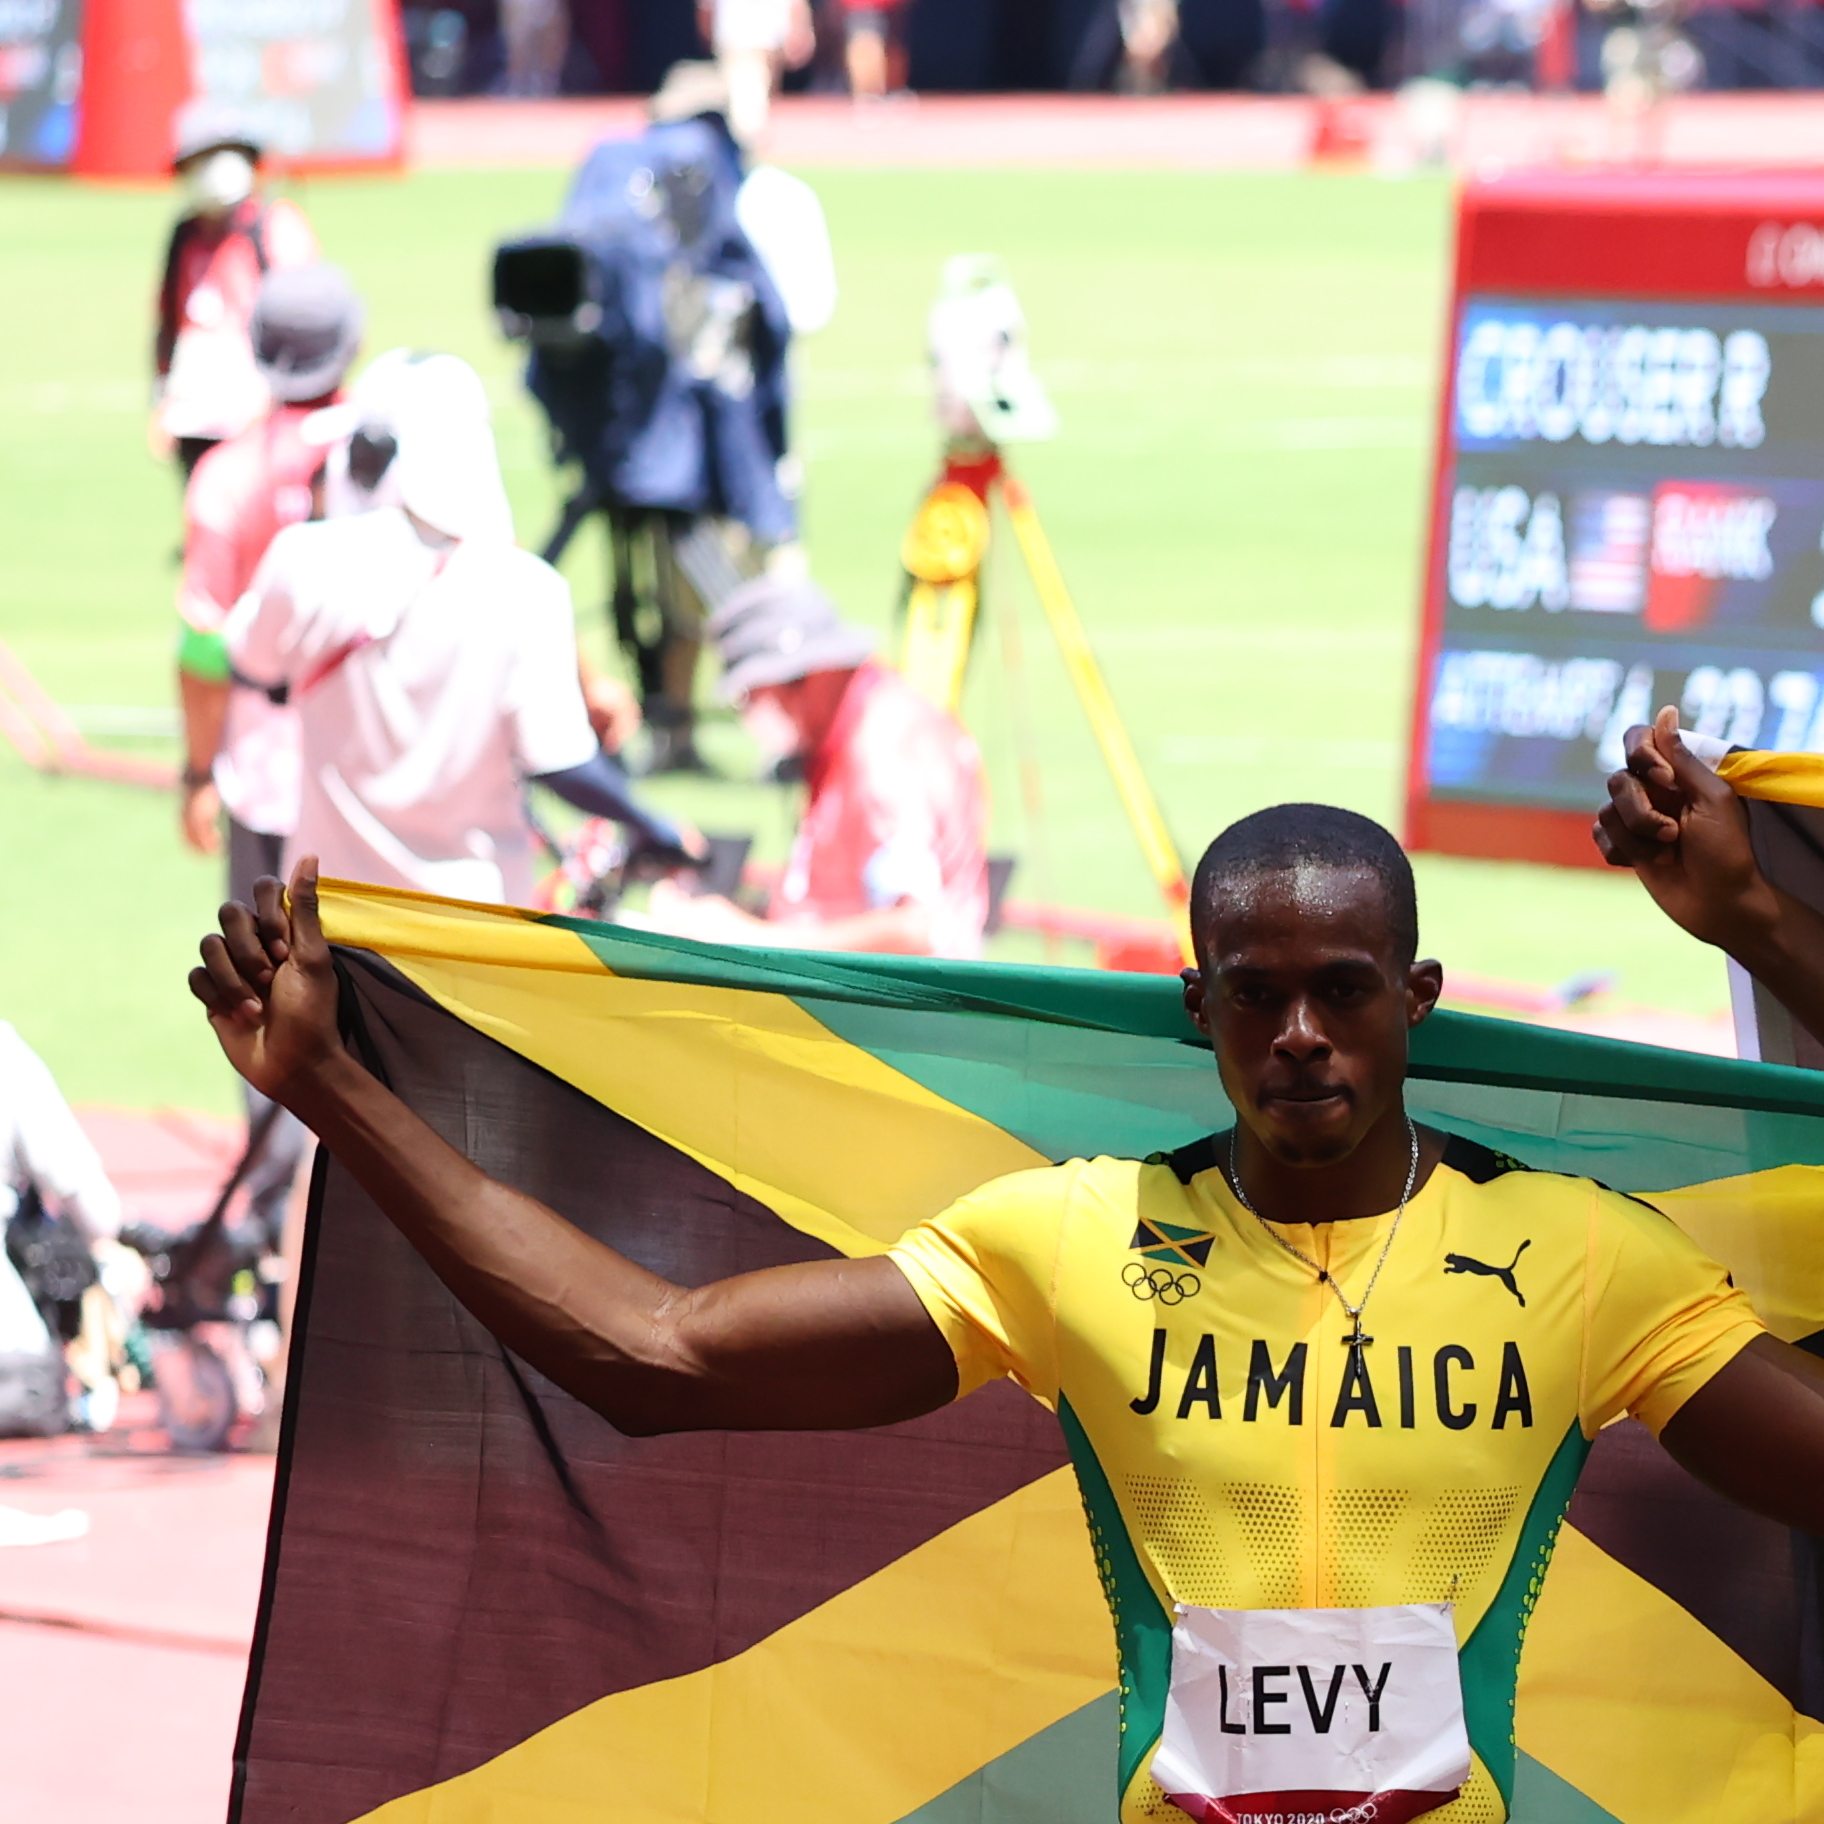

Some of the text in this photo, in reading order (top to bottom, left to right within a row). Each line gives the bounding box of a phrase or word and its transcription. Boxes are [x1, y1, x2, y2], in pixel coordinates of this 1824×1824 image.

[1458, 320, 1722, 448] CROUSER
[1448, 485, 1570, 614] USA
[1128, 1327, 1534, 1431] JAMAICA
[1217, 1661, 1393, 1735] LEVY
